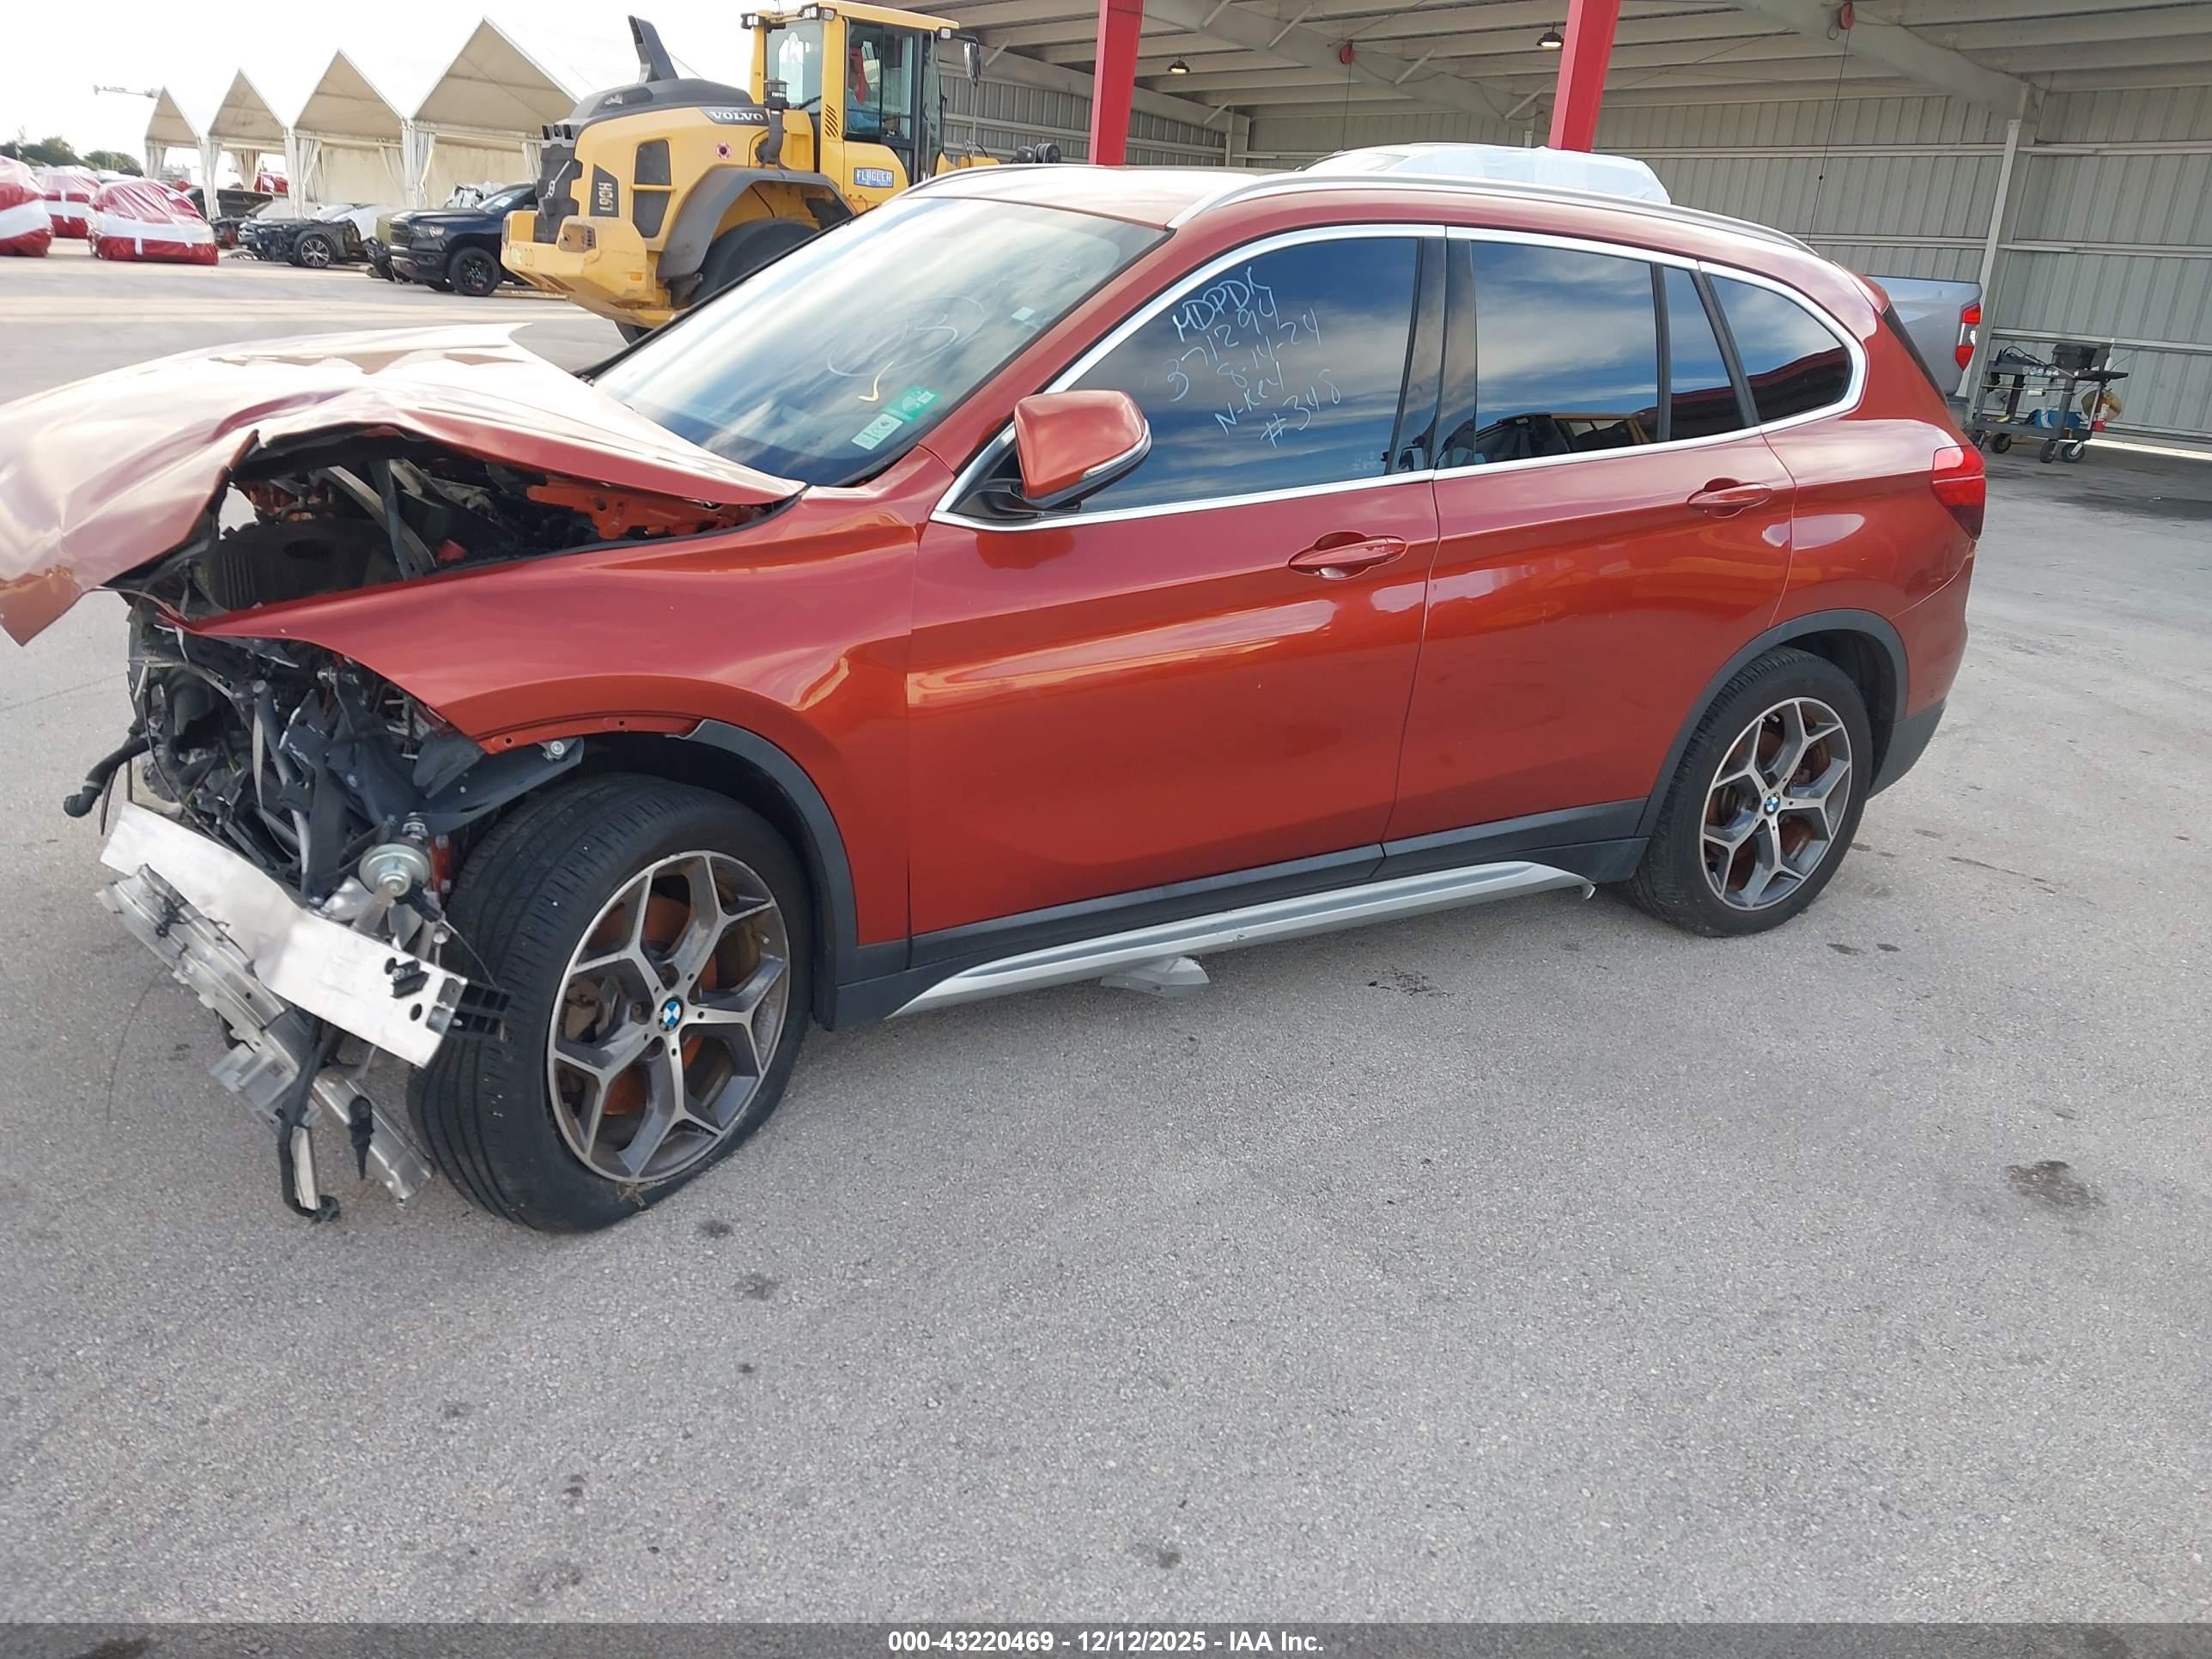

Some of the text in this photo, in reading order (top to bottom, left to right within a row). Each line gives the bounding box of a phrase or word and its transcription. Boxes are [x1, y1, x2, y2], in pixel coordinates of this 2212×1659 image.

[709, 111, 763, 121] VOLVO
[599, 182, 614, 211] L90H
[1260, 368, 1340, 448] #348
